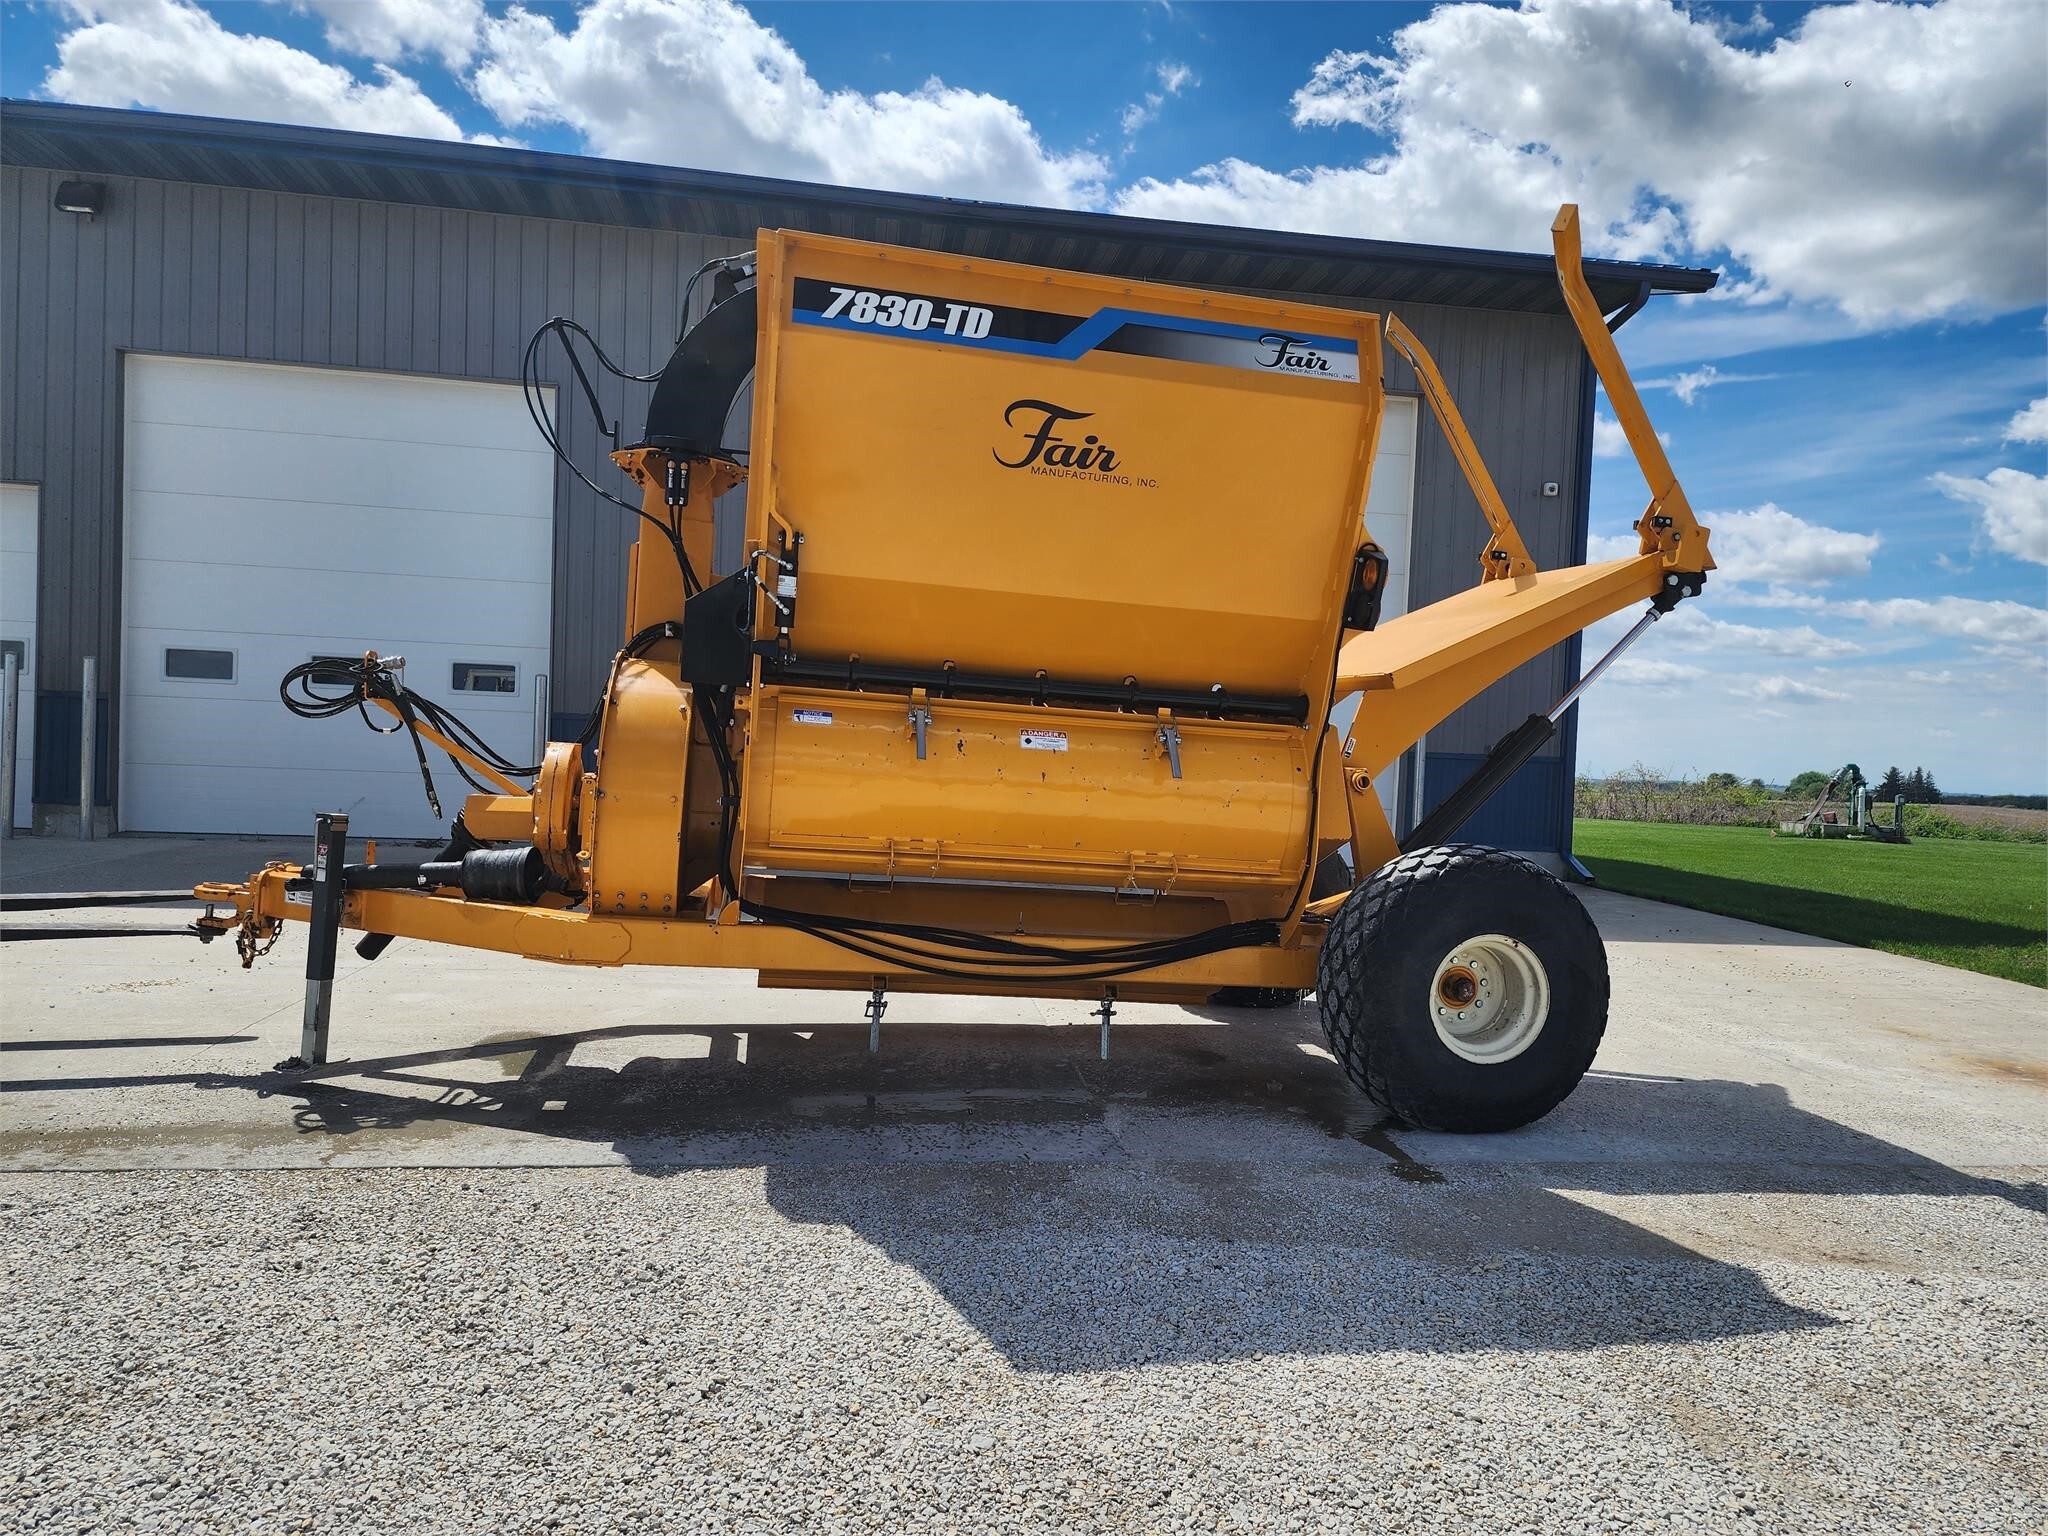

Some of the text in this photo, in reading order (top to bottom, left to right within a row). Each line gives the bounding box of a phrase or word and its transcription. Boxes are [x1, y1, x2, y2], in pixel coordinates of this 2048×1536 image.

[821, 287, 994, 339] 7830-TD
[1255, 333, 1332, 371] Fair
[992, 399, 1121, 472] Fair
[1030, 466, 1160, 489] MANUFACTURING, INC.
[1028, 730, 1059, 738] DANGER
